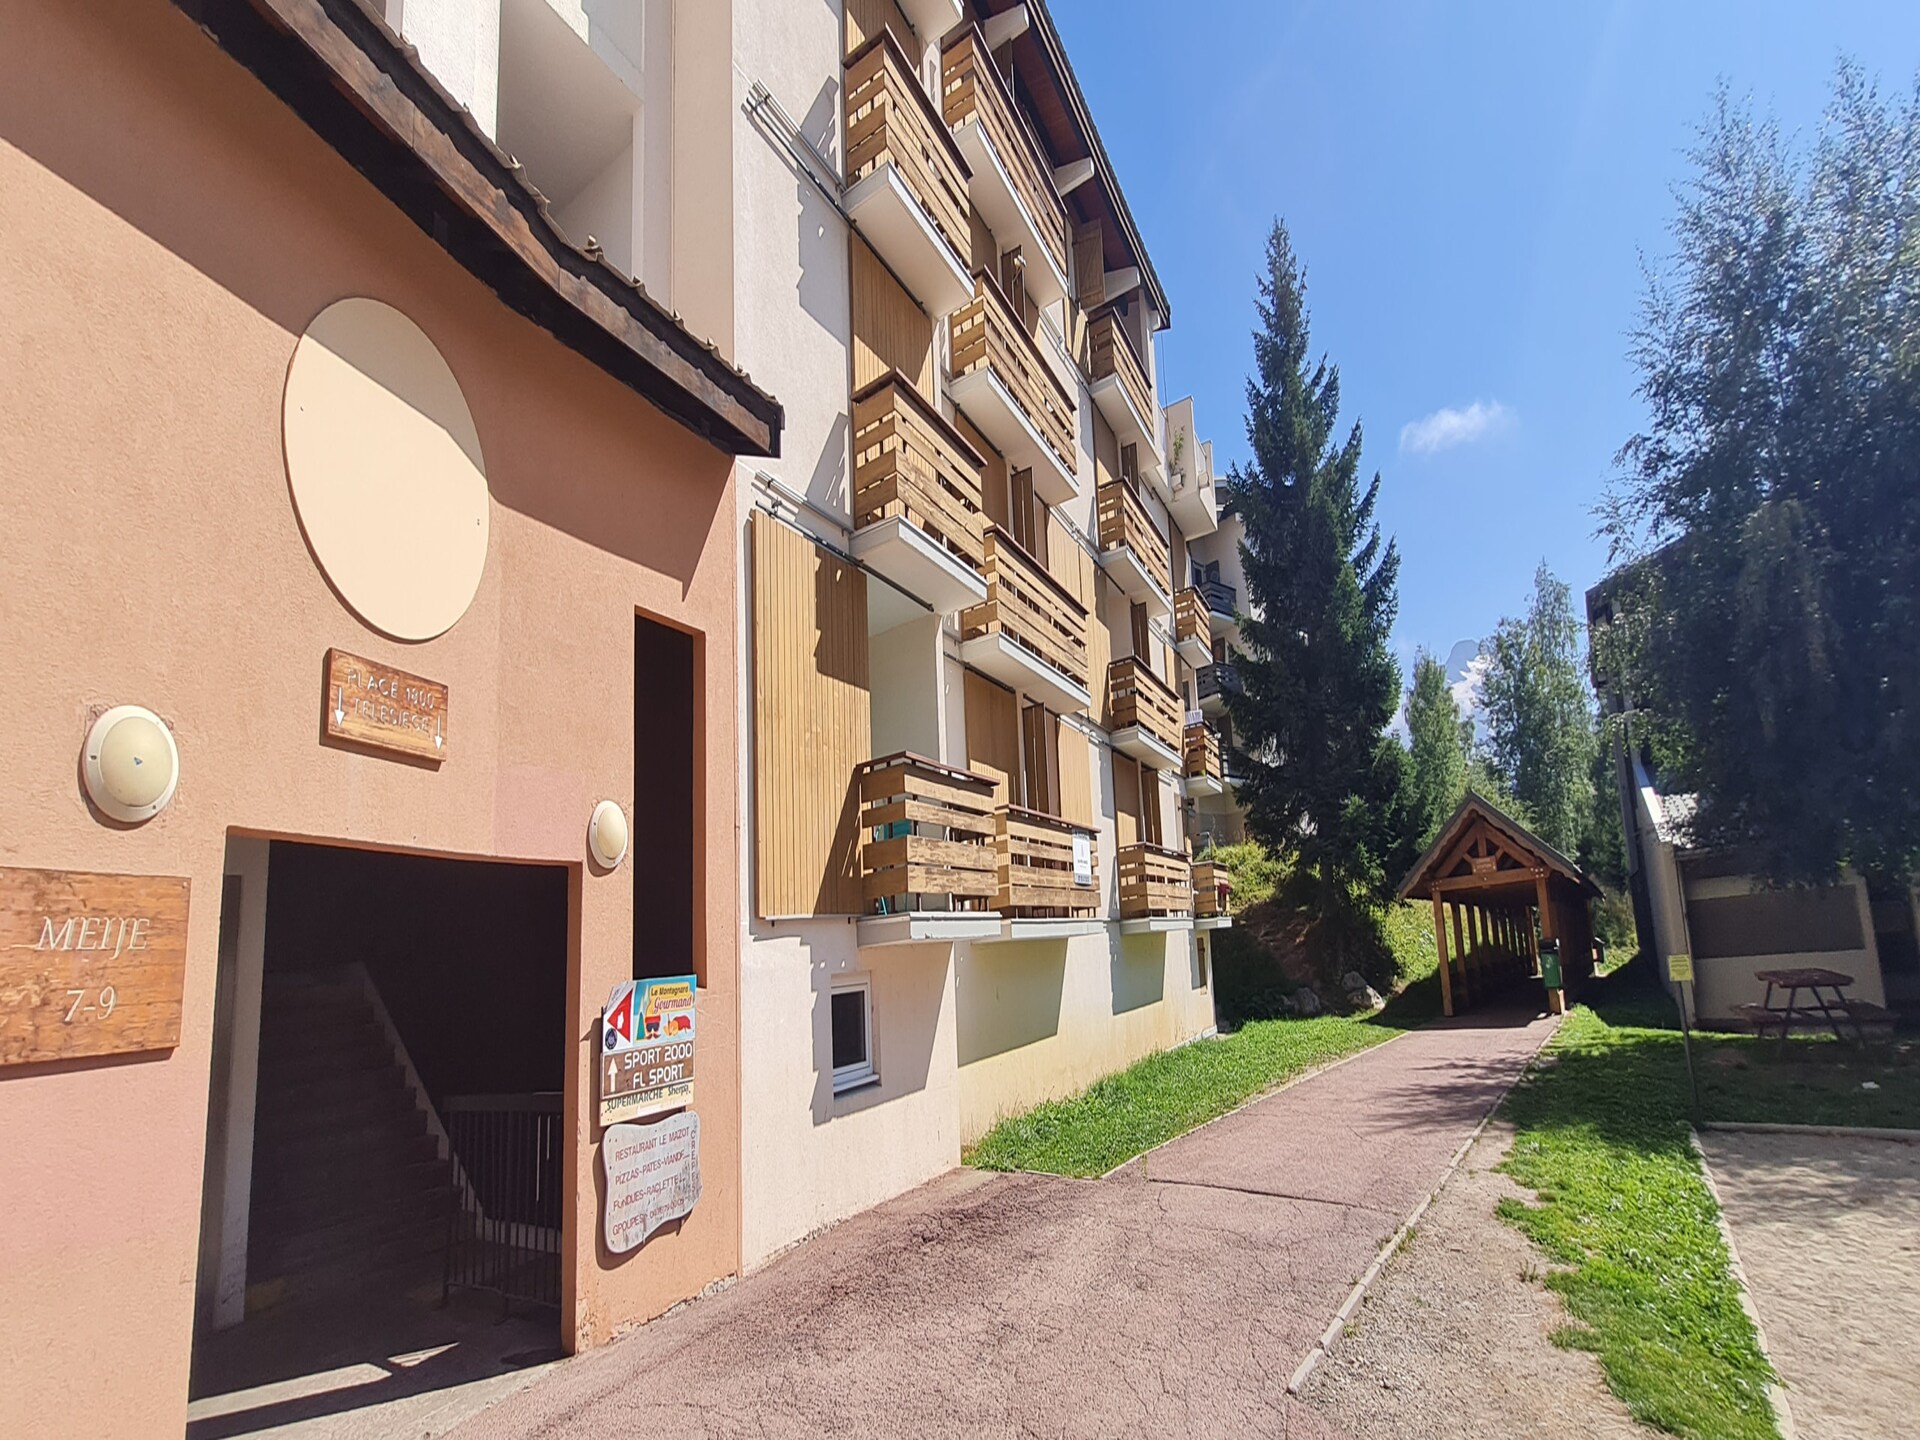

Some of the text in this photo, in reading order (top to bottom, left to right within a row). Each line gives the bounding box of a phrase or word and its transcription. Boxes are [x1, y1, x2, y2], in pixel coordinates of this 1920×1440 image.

[347, 668, 399, 699] PLACE
[36, 916, 150, 960] MEIJE
[64, 985, 118, 1023] 7-9
[653, 996, 693, 1013] Gourmand
[624, 1042, 693, 1070] SPORT 2000
[632, 1063, 685, 1089] FL SPORT
[615, 1126, 690, 1162] RESTAURANT LE MAZOT
